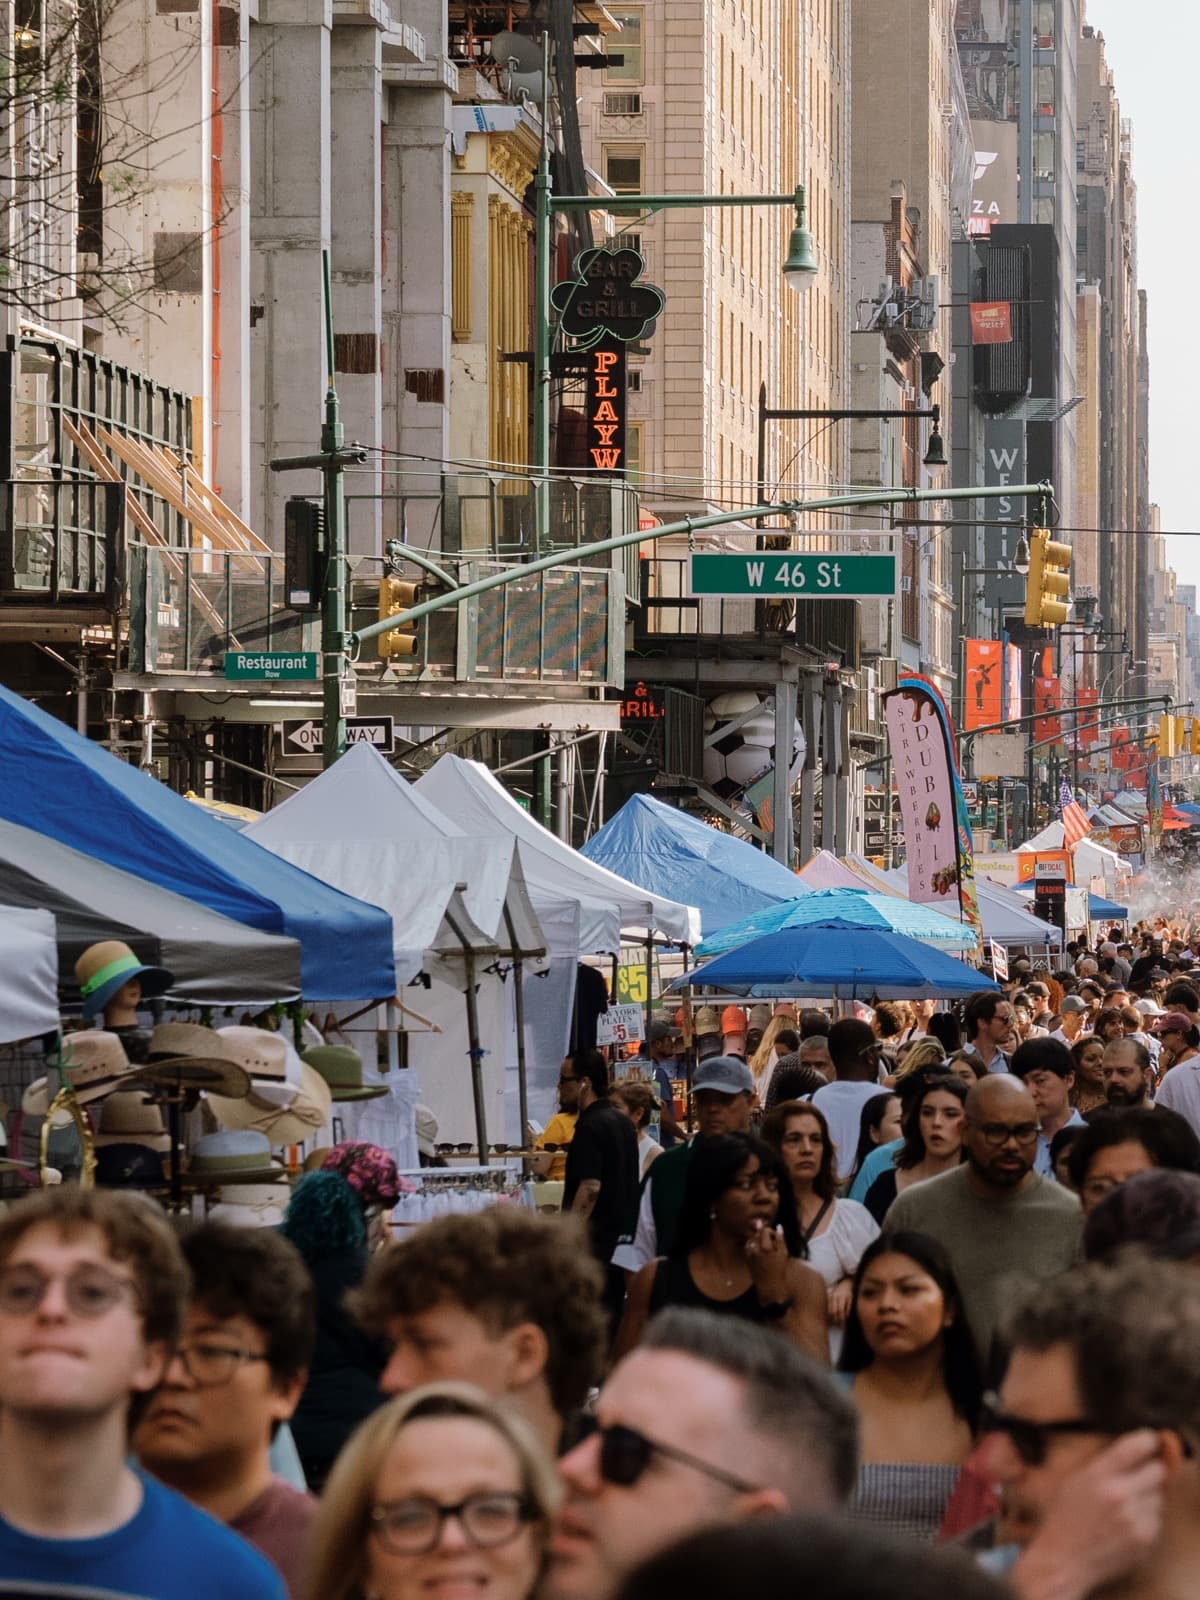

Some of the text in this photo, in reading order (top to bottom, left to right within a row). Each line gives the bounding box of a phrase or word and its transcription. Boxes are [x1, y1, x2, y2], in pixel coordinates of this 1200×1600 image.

[588, 260, 634, 278] BAR
[603, 281, 616, 297] &
[577, 300, 644, 318] GRILL
[590, 352, 621, 469] PLAYW
[990, 448, 1019, 579] WESTIN
[746, 562, 842, 588] W 46 St
[237, 655, 307, 670] Restaurant
[634, 681, 648, 697] &
[619, 700, 665, 718] RIL
[300, 728, 378, 744] ON WAY
[897, 707, 926, 890] STRAWBERRIES
[618, 965, 648, 1002] $5
[613, 1023, 627, 1040] $5
